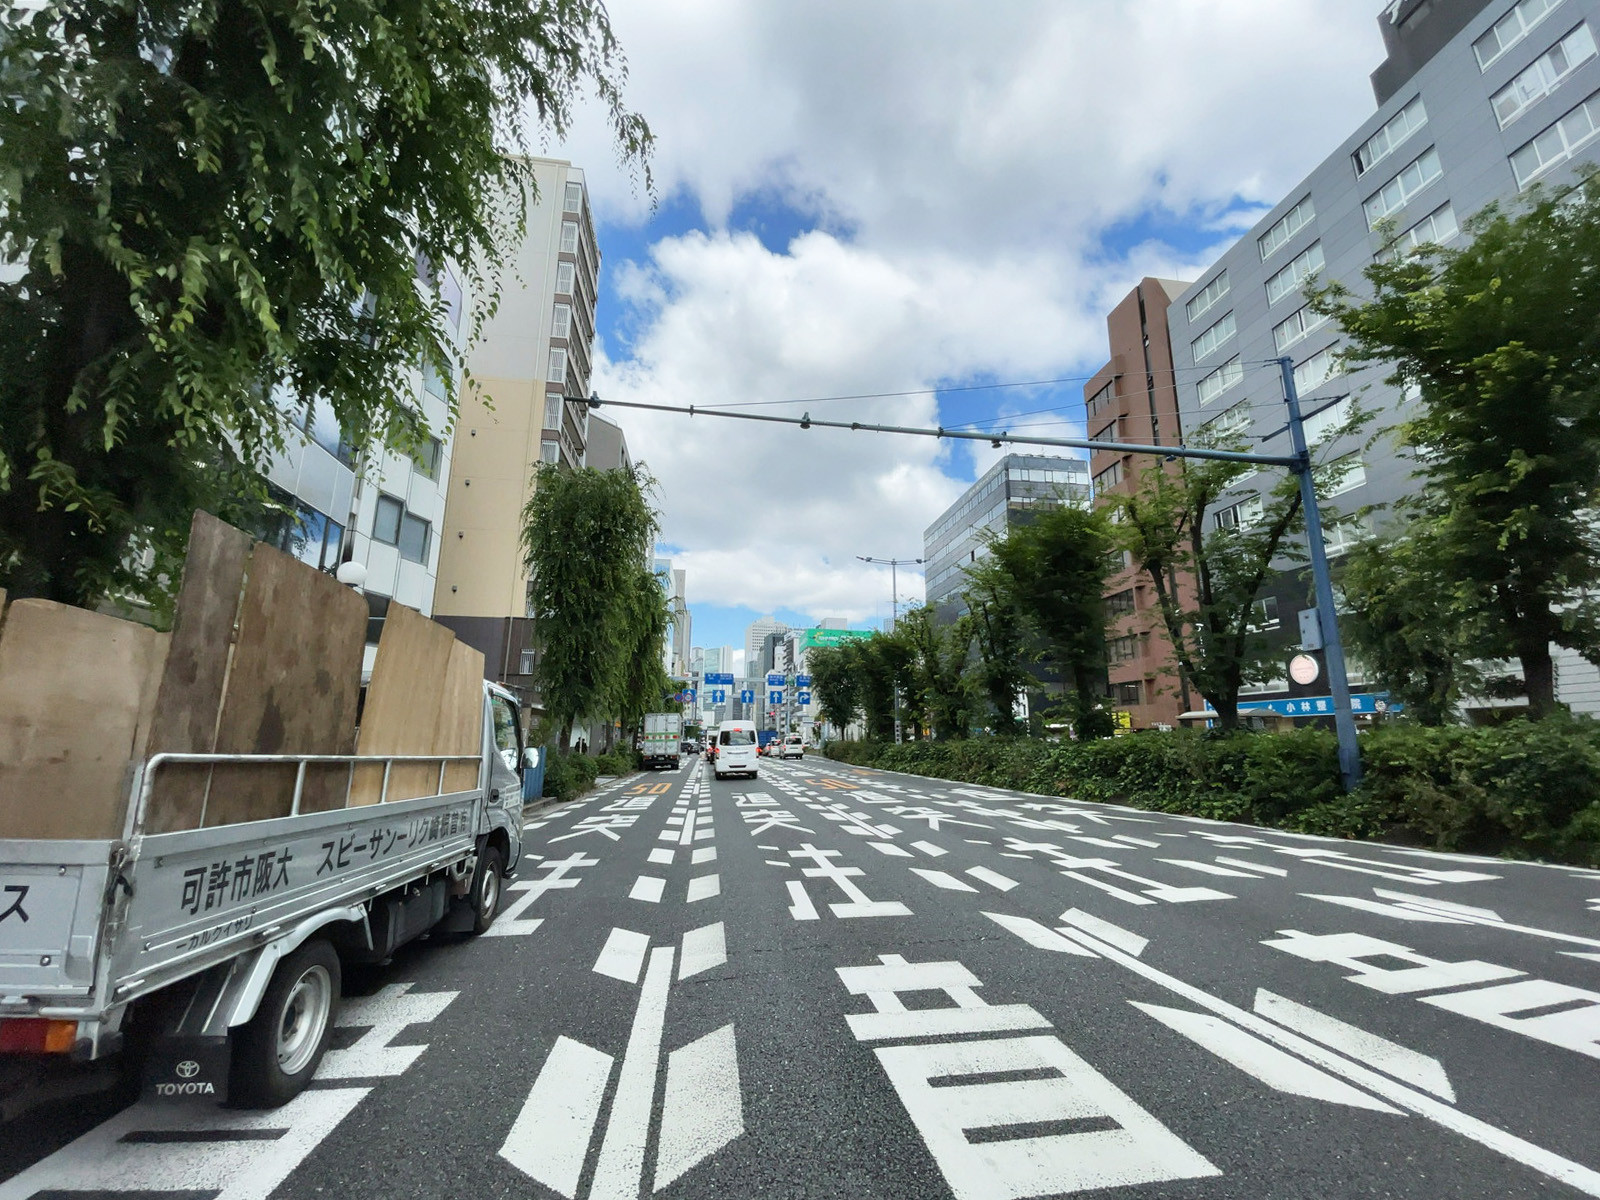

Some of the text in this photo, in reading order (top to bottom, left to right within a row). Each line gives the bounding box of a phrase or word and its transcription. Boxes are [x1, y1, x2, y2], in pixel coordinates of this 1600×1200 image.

[1286, 698, 1362, 713] 小林整院
[623, 783, 672, 795] 50
[156, 1082, 215, 1095] TOYOTA
